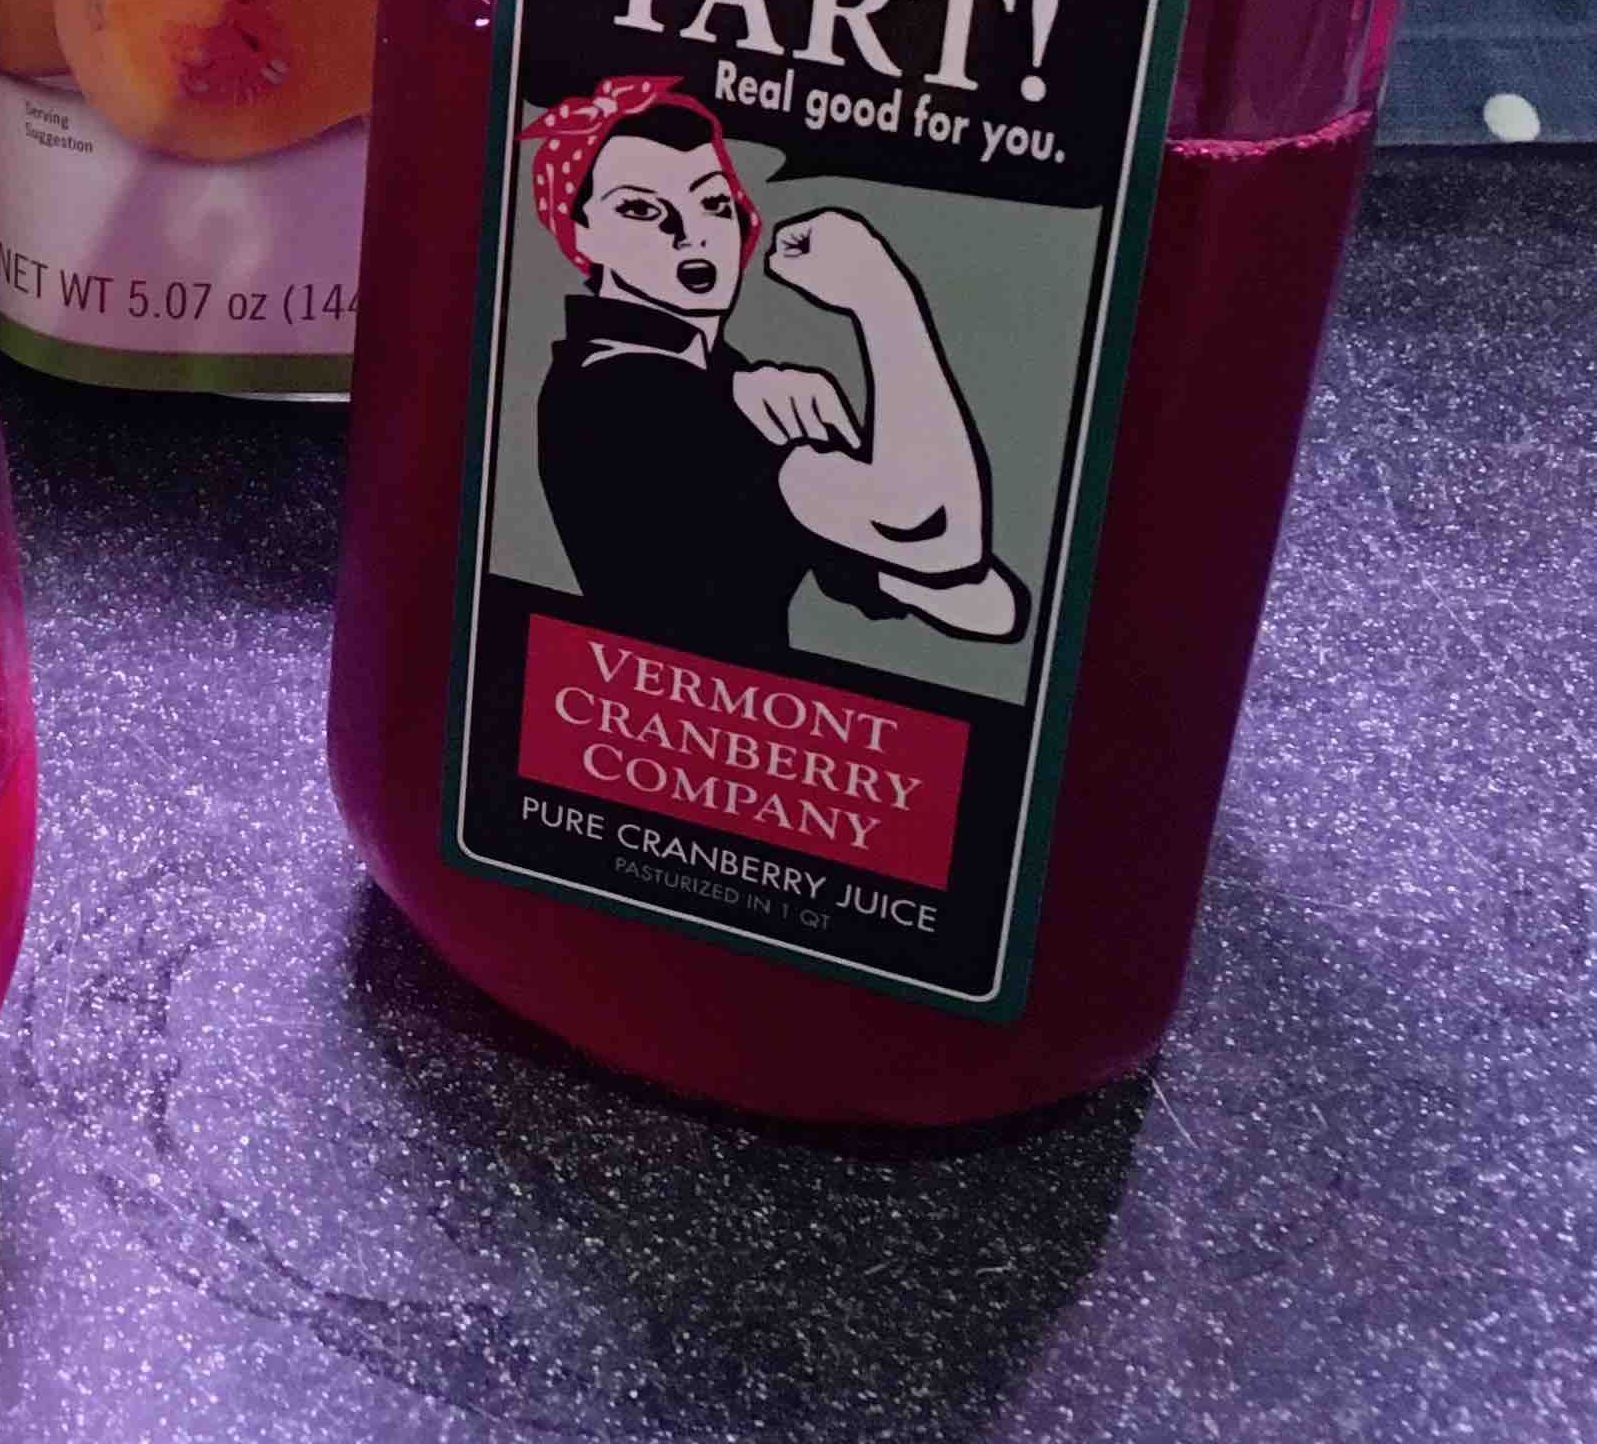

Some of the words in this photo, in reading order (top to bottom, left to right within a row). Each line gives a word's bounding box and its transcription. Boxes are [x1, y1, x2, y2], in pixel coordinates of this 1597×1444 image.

[25, 100, 69, 129] Serving
[25, 122, 93, 154] Suggestion
[715, 60, 792, 112] Real
[806, 86, 901, 132] good
[914, 98, 968, 145] for
[983, 117, 1065, 164] you.
[59, 269, 113, 313] WT
[129, 280, 212, 319] 5.07
[228, 292, 267, 320] oz
[589, 641, 897, 752] VERMONT
[554, 687, 923, 812] CRANBERRY
[582, 743, 881, 851] COMPANY
[522, 796, 605, 840] PURE
[617, 823, 827, 899] CRANBERRY
[836, 883, 938, 933] JUICE
[615, 857, 739, 904] PASTURIZED
[747, 893, 770, 913] IN
[799, 909, 830, 930] QT
